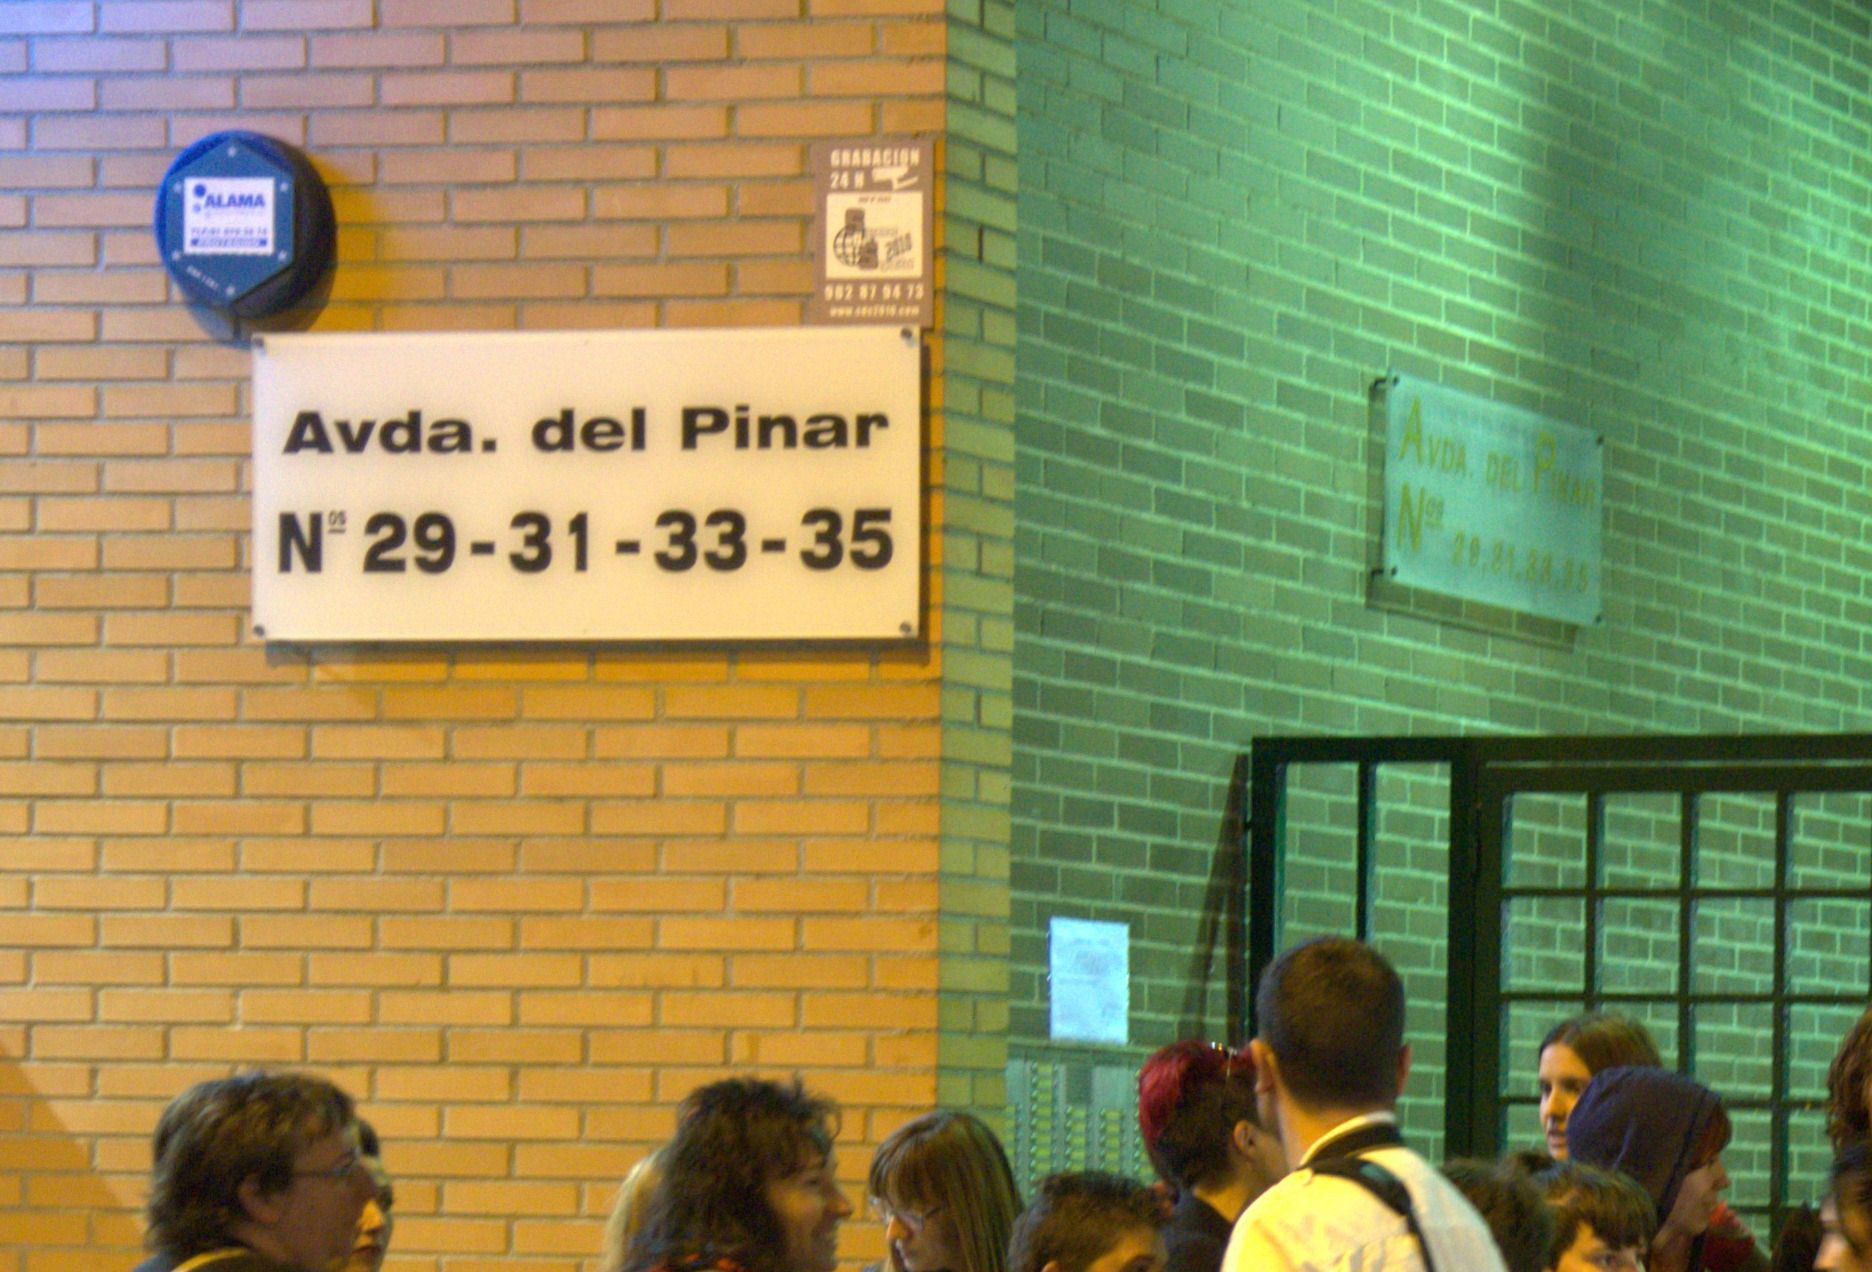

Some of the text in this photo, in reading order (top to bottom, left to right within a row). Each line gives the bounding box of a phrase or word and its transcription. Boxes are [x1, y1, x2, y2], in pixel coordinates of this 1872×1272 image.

[203, 192, 266, 209] ALAMA
[283, 404, 889, 454] Avda. del Pinar
